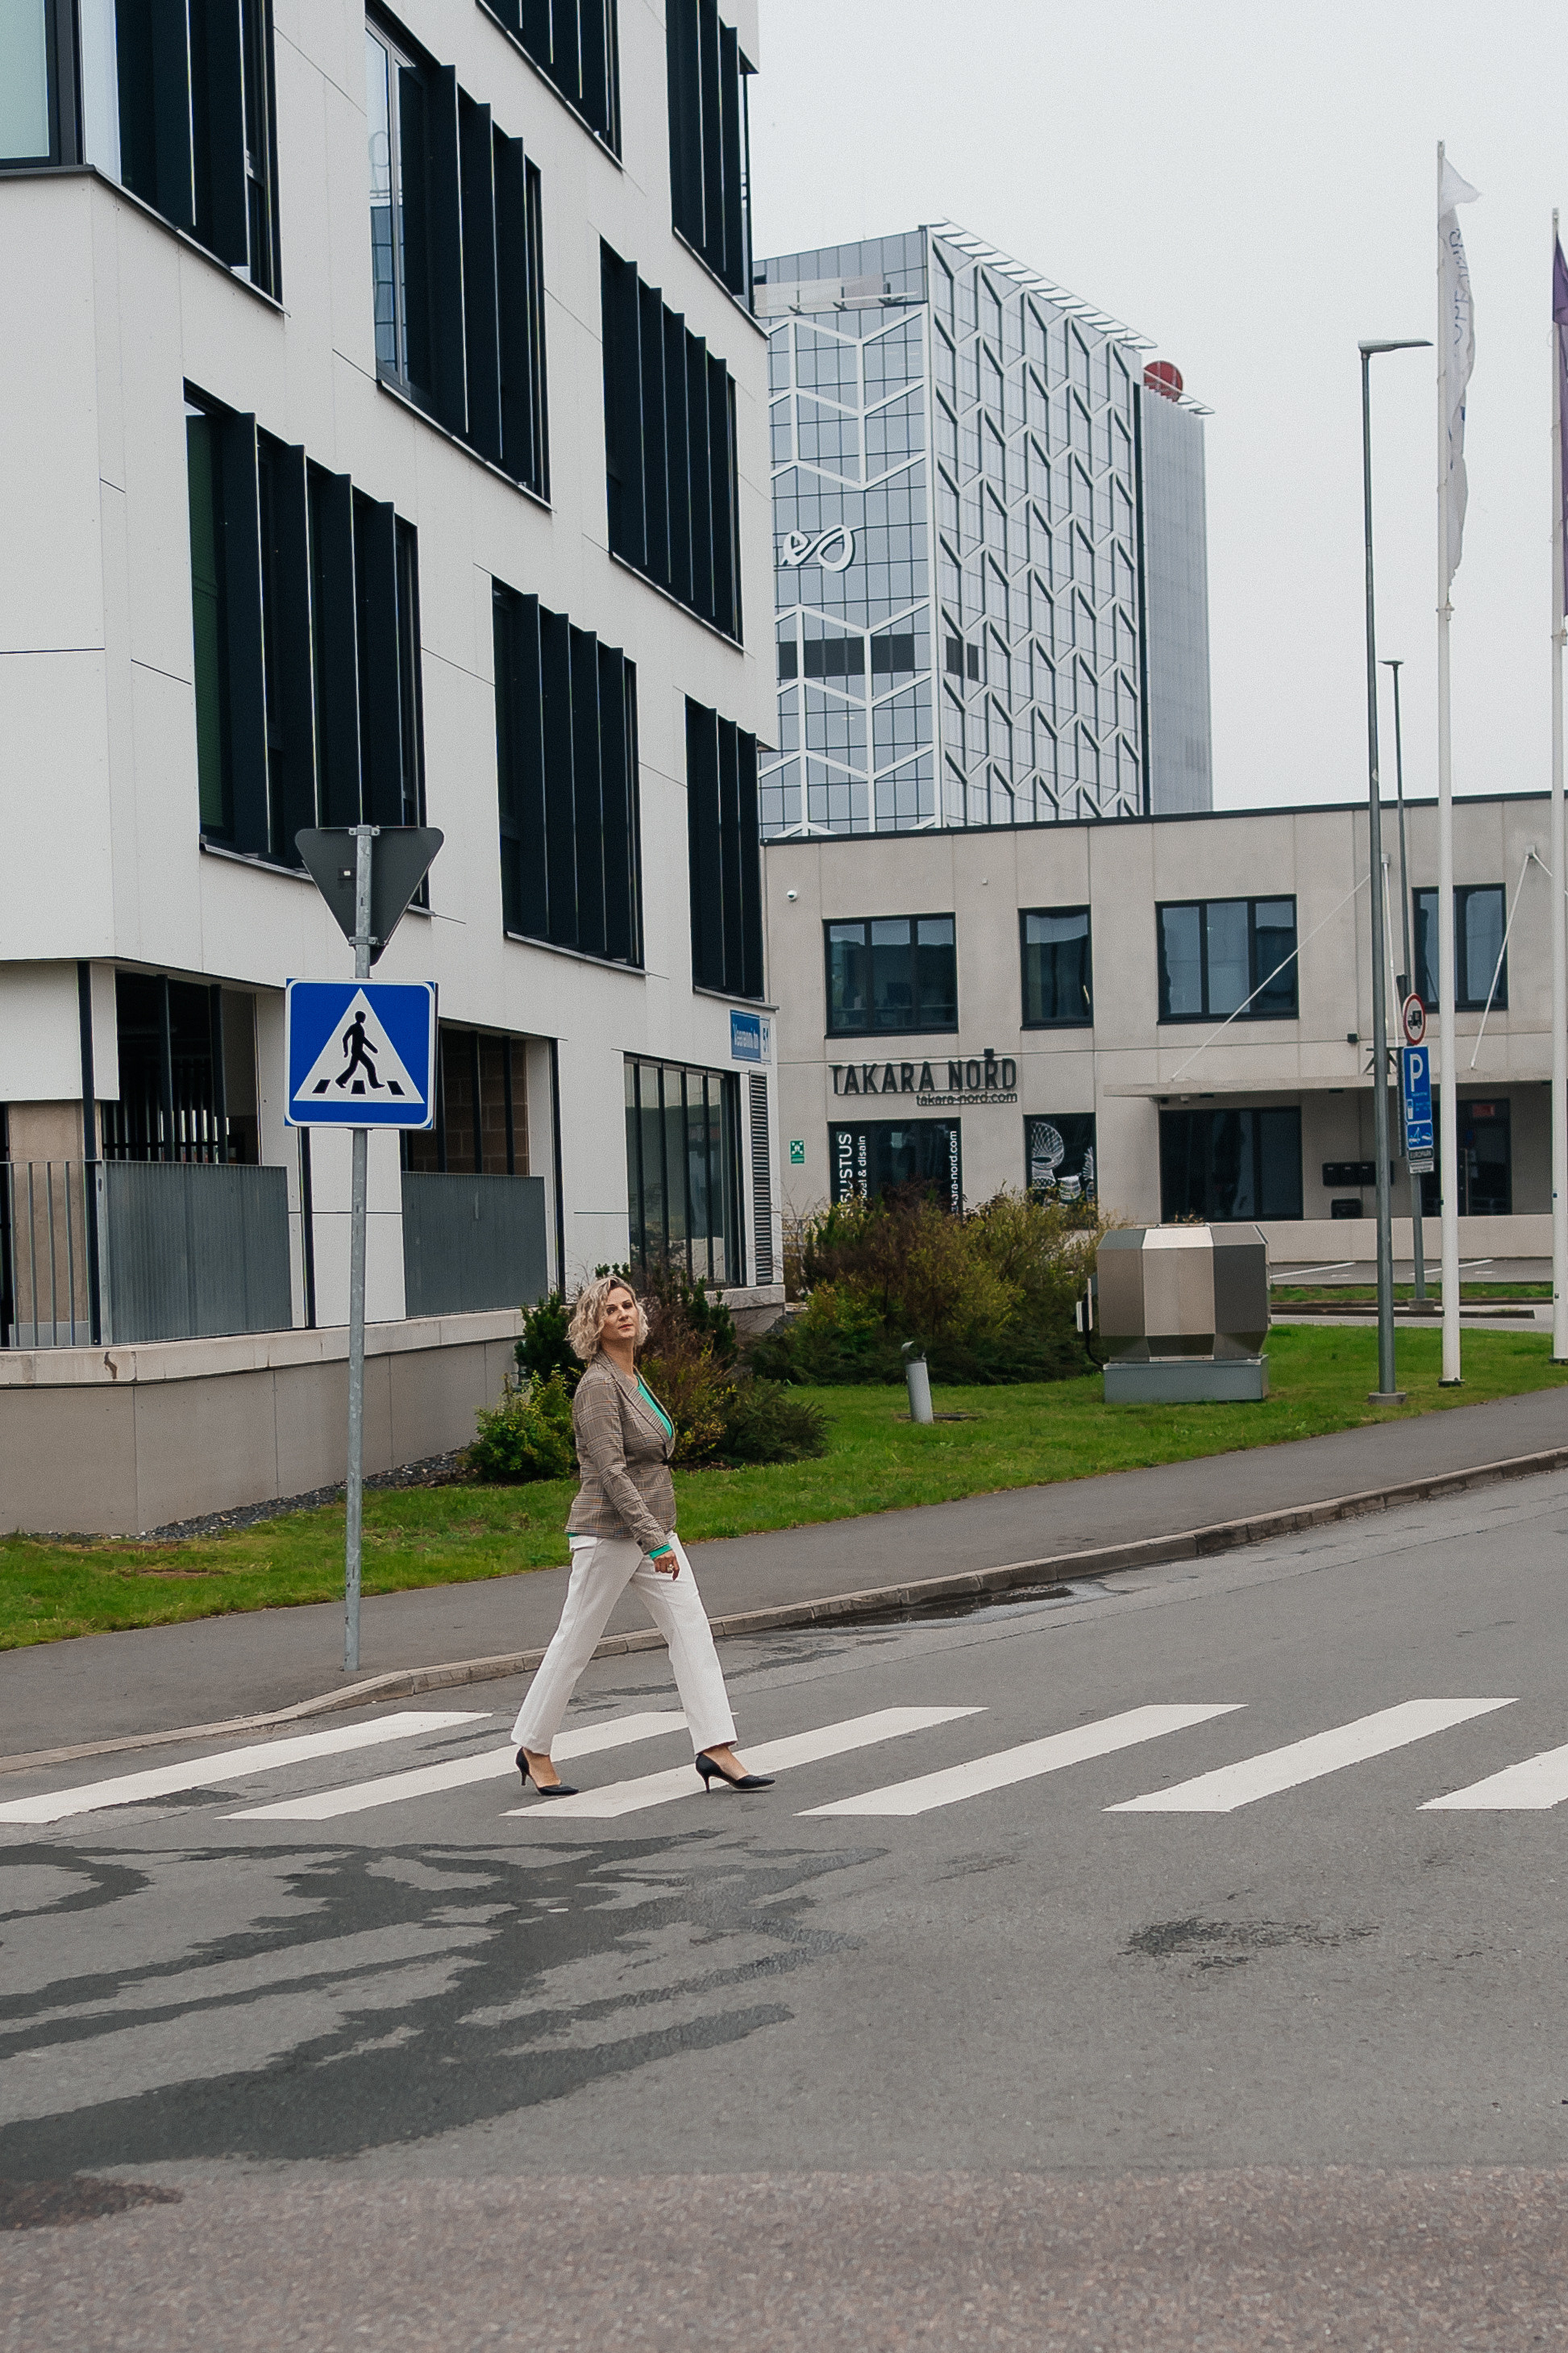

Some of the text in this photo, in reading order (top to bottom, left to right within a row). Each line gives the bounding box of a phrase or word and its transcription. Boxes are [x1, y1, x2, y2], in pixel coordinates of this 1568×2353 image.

[829, 1058, 1017, 1094] TAKARA NORD
[1410, 1053, 1423, 1093] P
[916, 1091, 1018, 1106] takara-nord.com
[858, 1135, 867, 1167] disain
[858, 1169, 867, 1177] &
